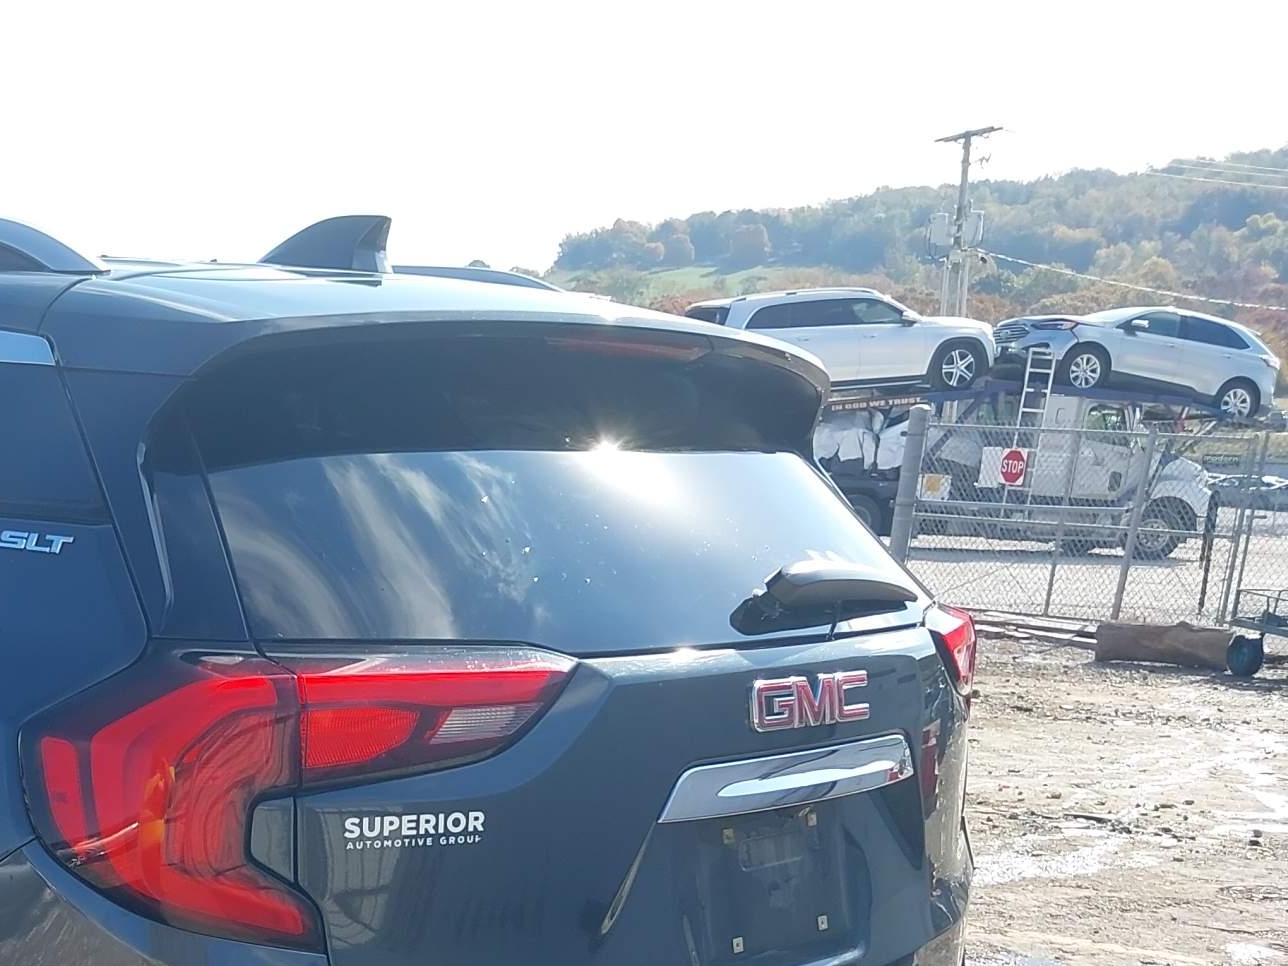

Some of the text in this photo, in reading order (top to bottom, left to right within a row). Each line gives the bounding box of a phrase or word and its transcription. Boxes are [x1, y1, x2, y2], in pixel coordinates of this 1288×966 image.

[869, 400, 887, 408] WE
[888, 397, 921, 406] TRUST
[1002, 459, 1024, 473] STOP
[750, 669, 870, 733] GMC
[343, 811, 486, 839] SUPERIOR
[346, 837, 433, 850] AUTOMOTIVE
